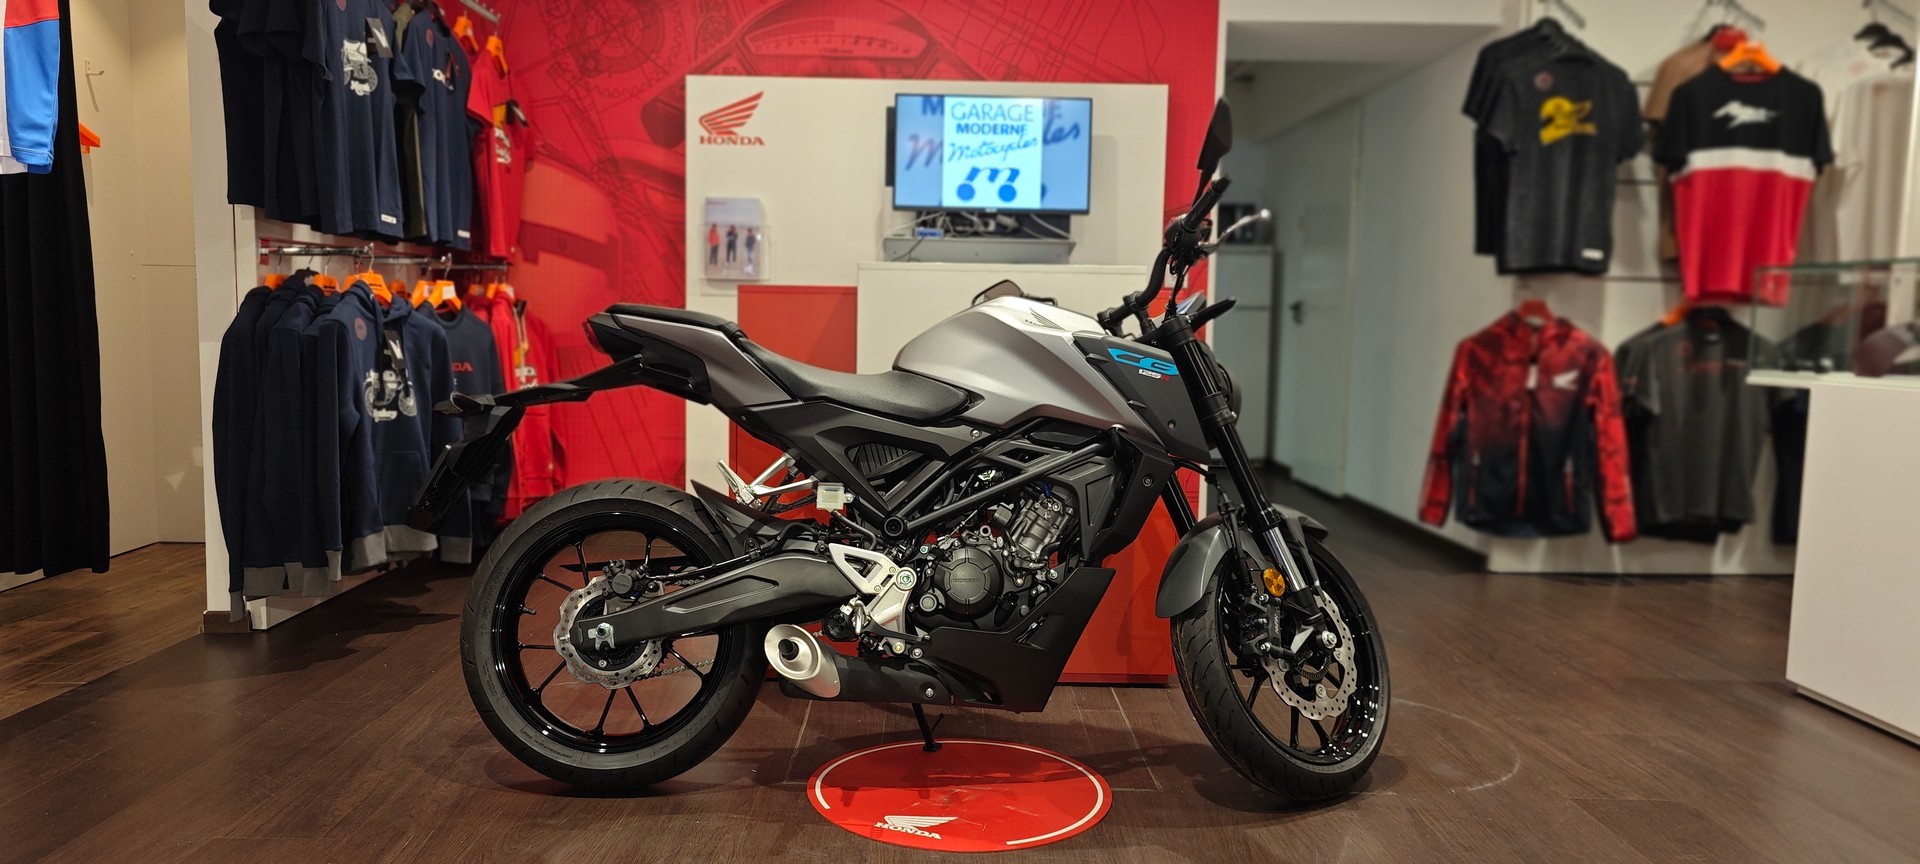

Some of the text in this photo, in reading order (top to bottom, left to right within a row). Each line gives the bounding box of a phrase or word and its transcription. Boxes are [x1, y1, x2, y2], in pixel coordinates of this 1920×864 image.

[951, 102, 1034, 122] GARAGE
[956, 122, 1028, 136] MODERNE
[699, 135, 765, 146] HONDA
[874, 822, 942, 840] HONDA
